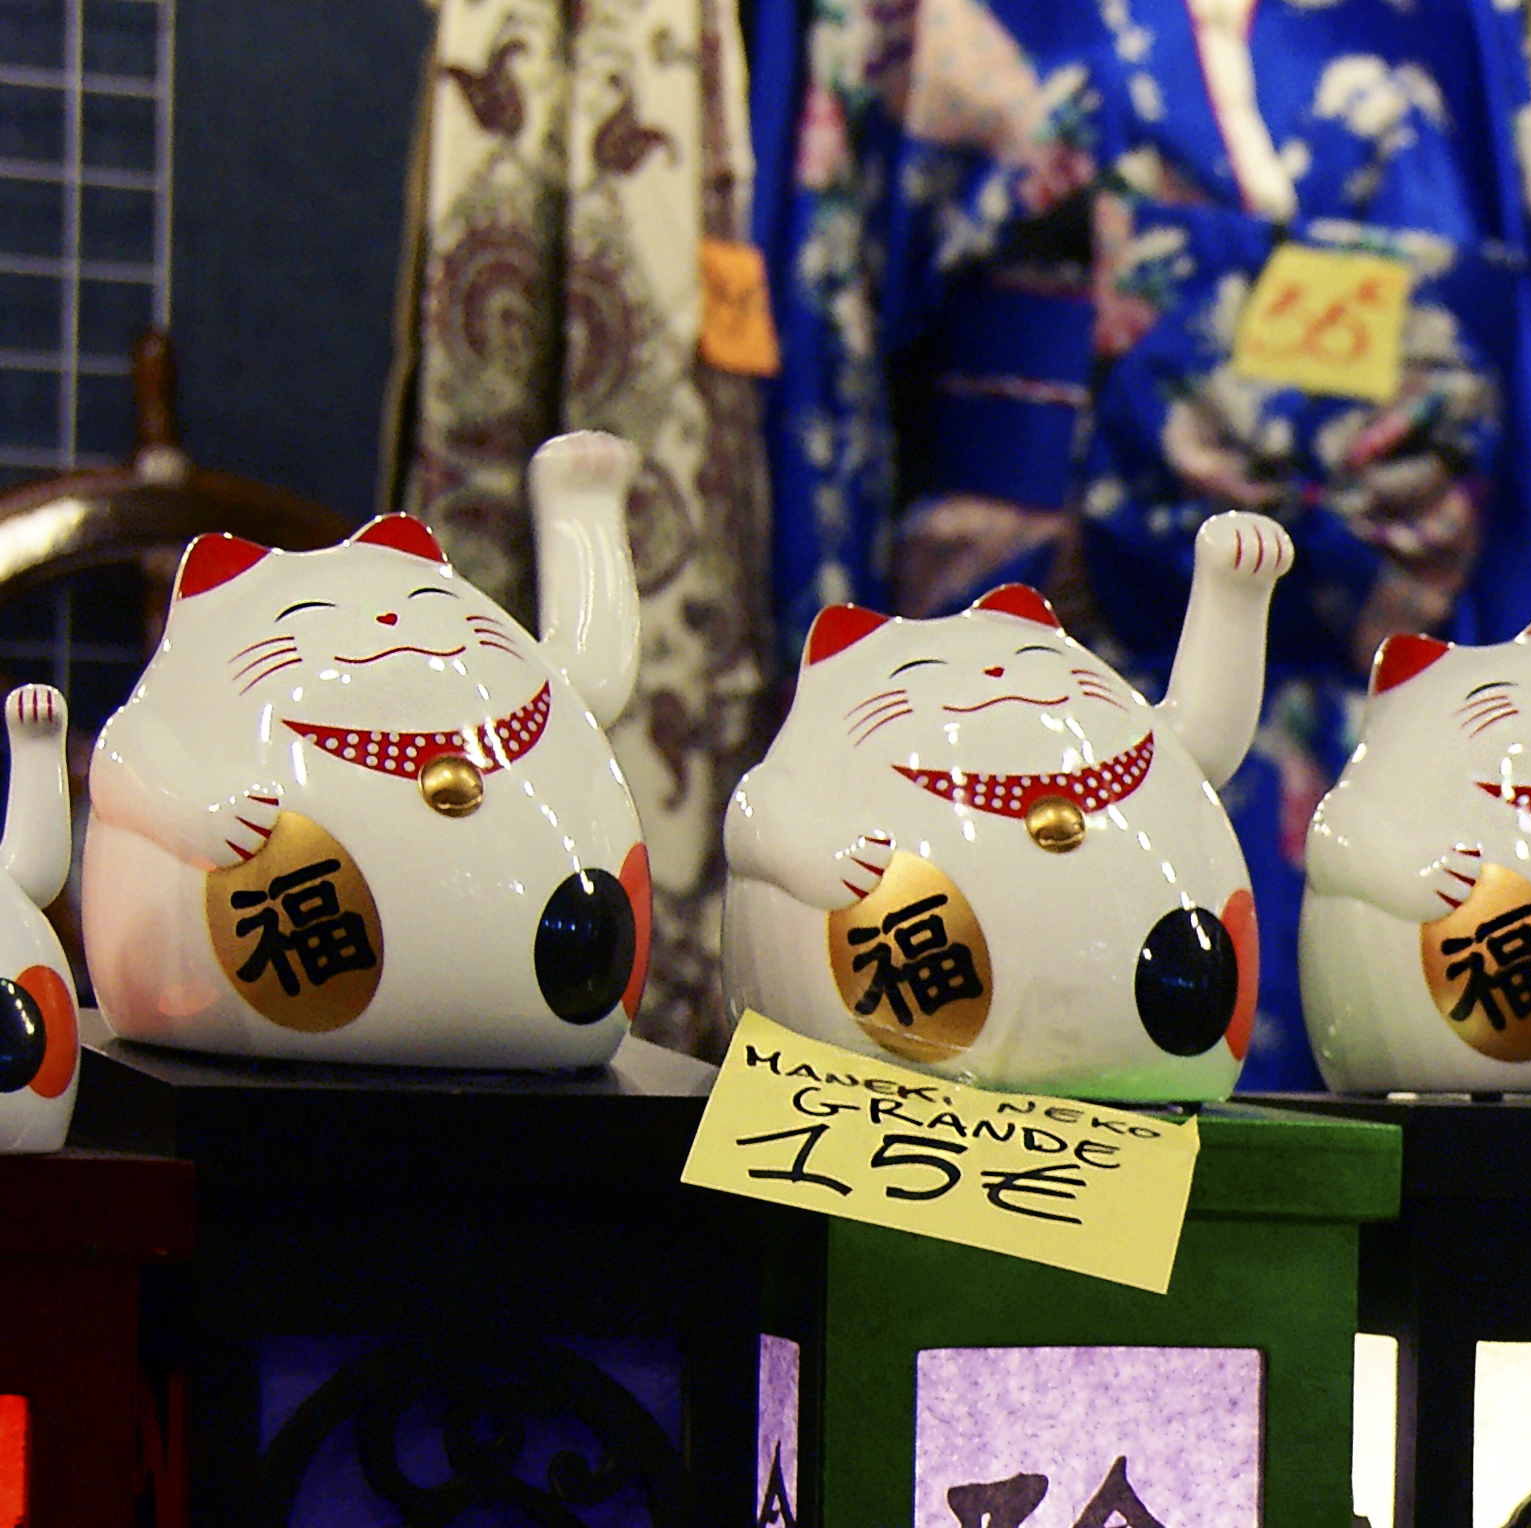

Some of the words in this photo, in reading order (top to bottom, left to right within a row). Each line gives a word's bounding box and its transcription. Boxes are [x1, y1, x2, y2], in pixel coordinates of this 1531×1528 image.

[232, 856, 379, 1001] 福
[847, 893, 984, 1025] 福
[792, 1087, 1122, 1169] GRANDE
[997, 1101, 1160, 1139] NEKO
[736, 1123, 1087, 1225] 15€
